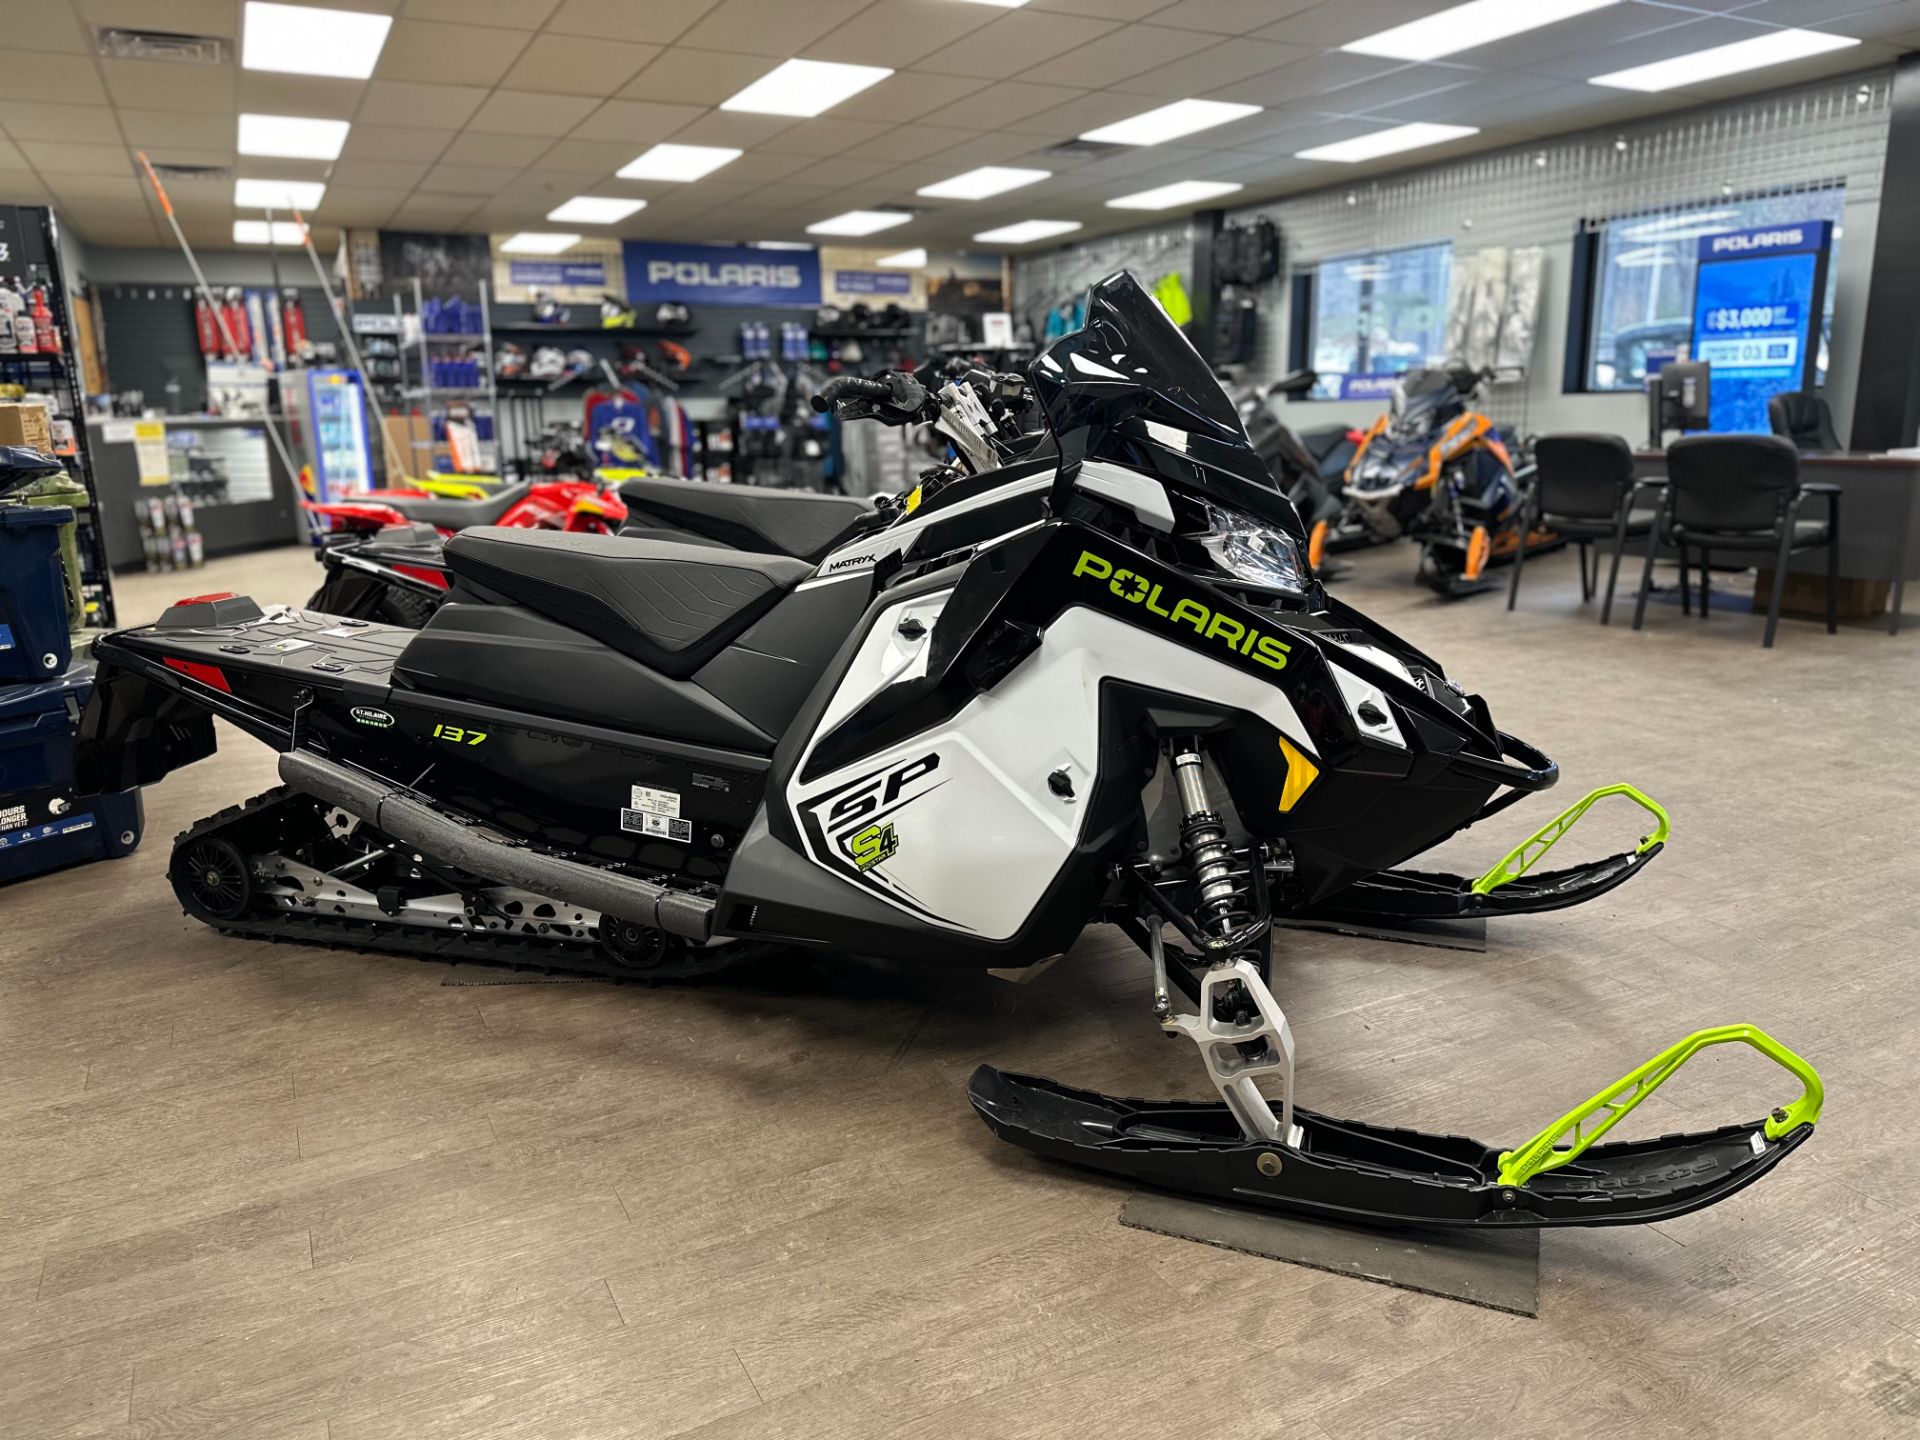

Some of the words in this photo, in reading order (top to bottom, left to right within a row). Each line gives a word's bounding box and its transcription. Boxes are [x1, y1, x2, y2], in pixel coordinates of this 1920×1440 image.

[1713, 228, 1803, 253] POLARIS
[648, 260, 802, 289] POLARIS
[829, 553, 877, 573] MATRYX
[1072, 550, 1292, 671] POLARIS
[433, 724, 487, 746] 137
[827, 752, 941, 835] SP
[14, 819, 29, 829] YETI
[851, 822, 899, 866] S4
[1520, 1133, 1560, 1175] POLARIS
